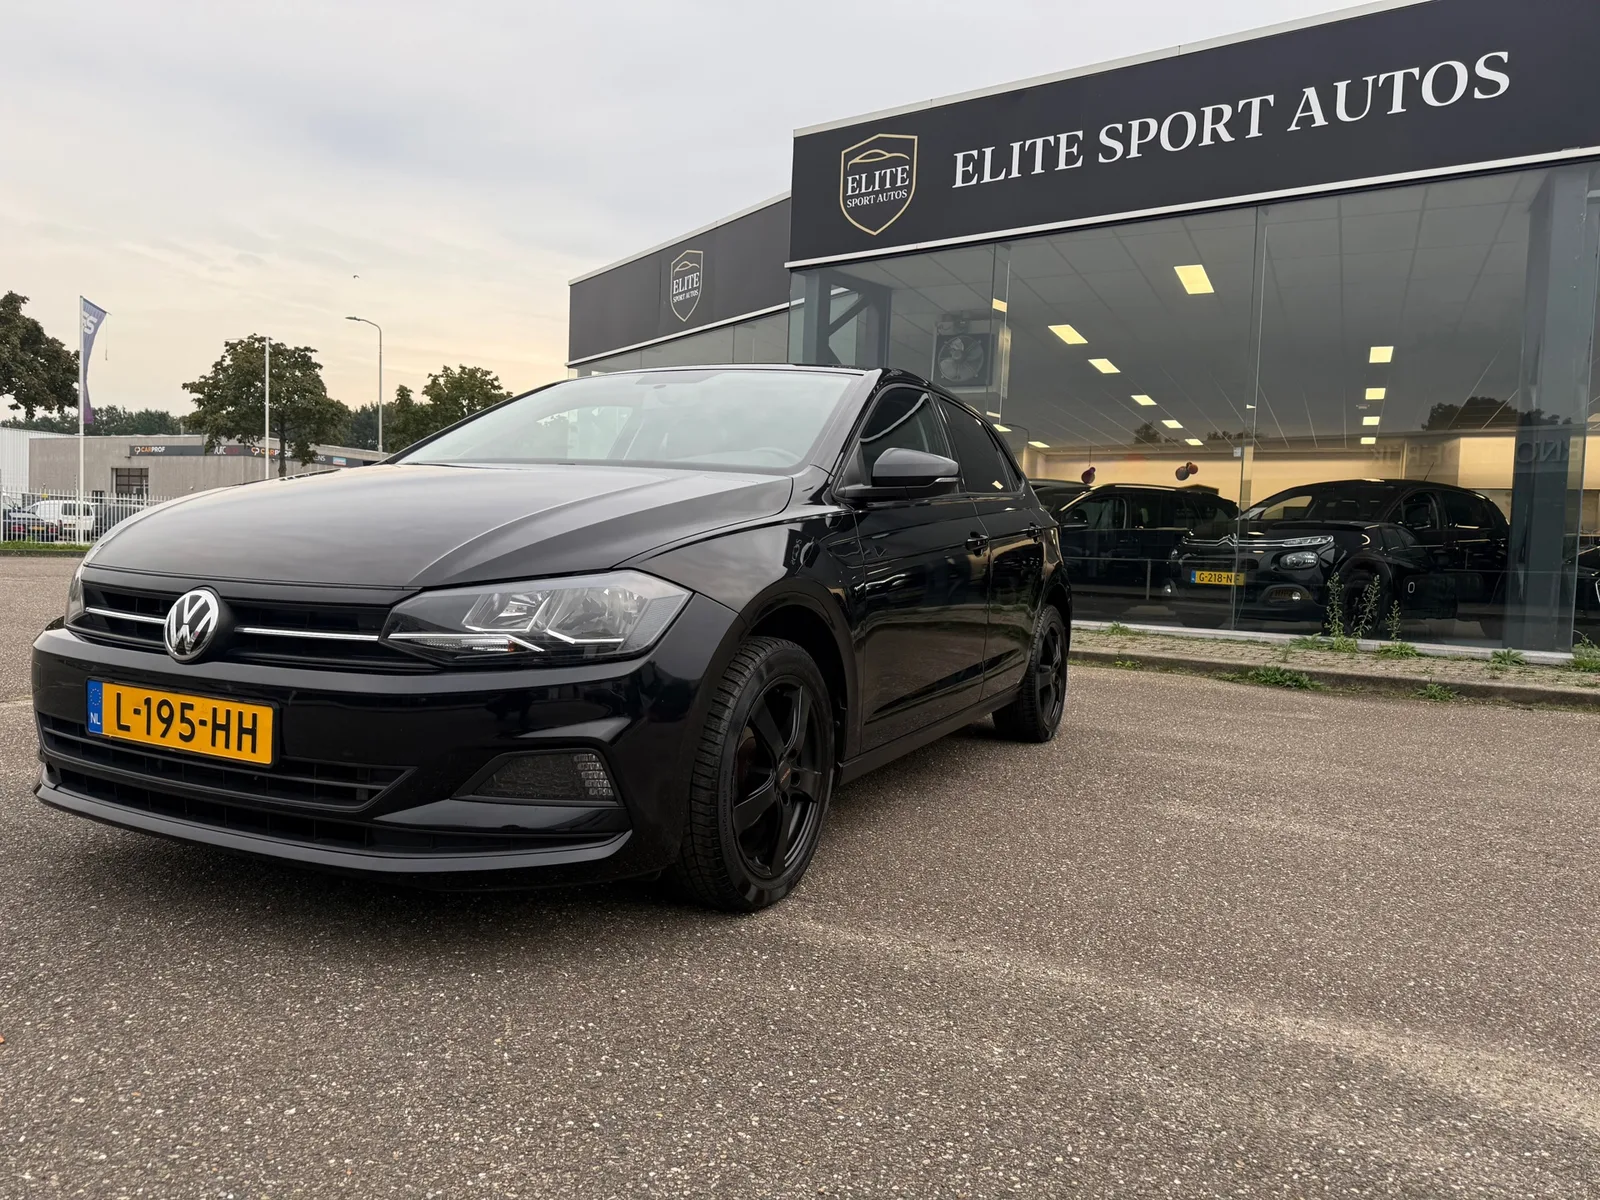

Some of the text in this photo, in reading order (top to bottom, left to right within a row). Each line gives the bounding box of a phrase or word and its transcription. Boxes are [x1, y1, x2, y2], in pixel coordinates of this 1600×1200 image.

[952, 50, 1511, 188] ELITE SPORT AUTOS
[846, 165, 910, 196] ELITE
[846, 189, 908, 208] SPORT AUTOS
[673, 272, 700, 294] ELITE
[90, 692, 258, 754] NL L-195-HH
